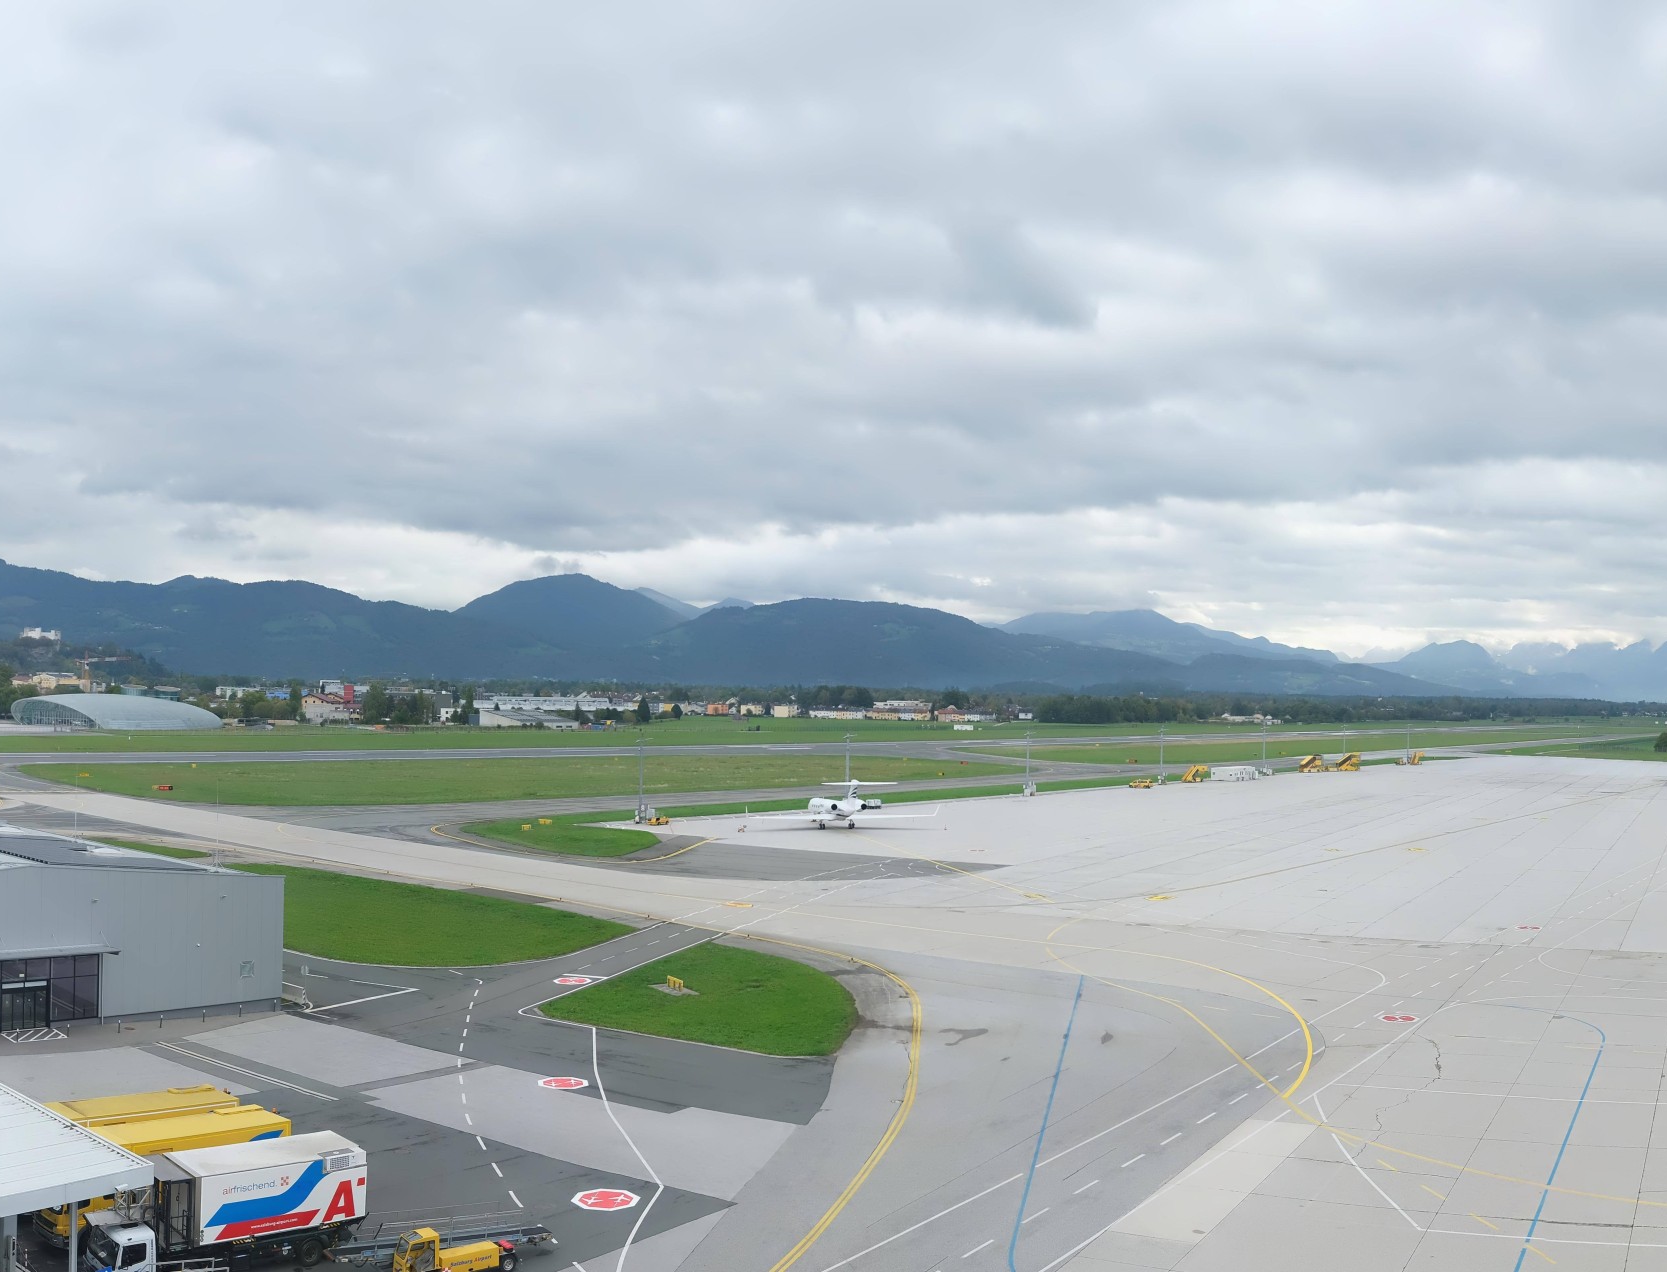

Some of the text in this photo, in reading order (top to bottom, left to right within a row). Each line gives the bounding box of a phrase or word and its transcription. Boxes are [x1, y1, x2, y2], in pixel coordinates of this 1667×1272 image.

[222, 1179, 278, 1196] airfrischend.
[449, 1254, 493, 1268] Salzburg Airport
